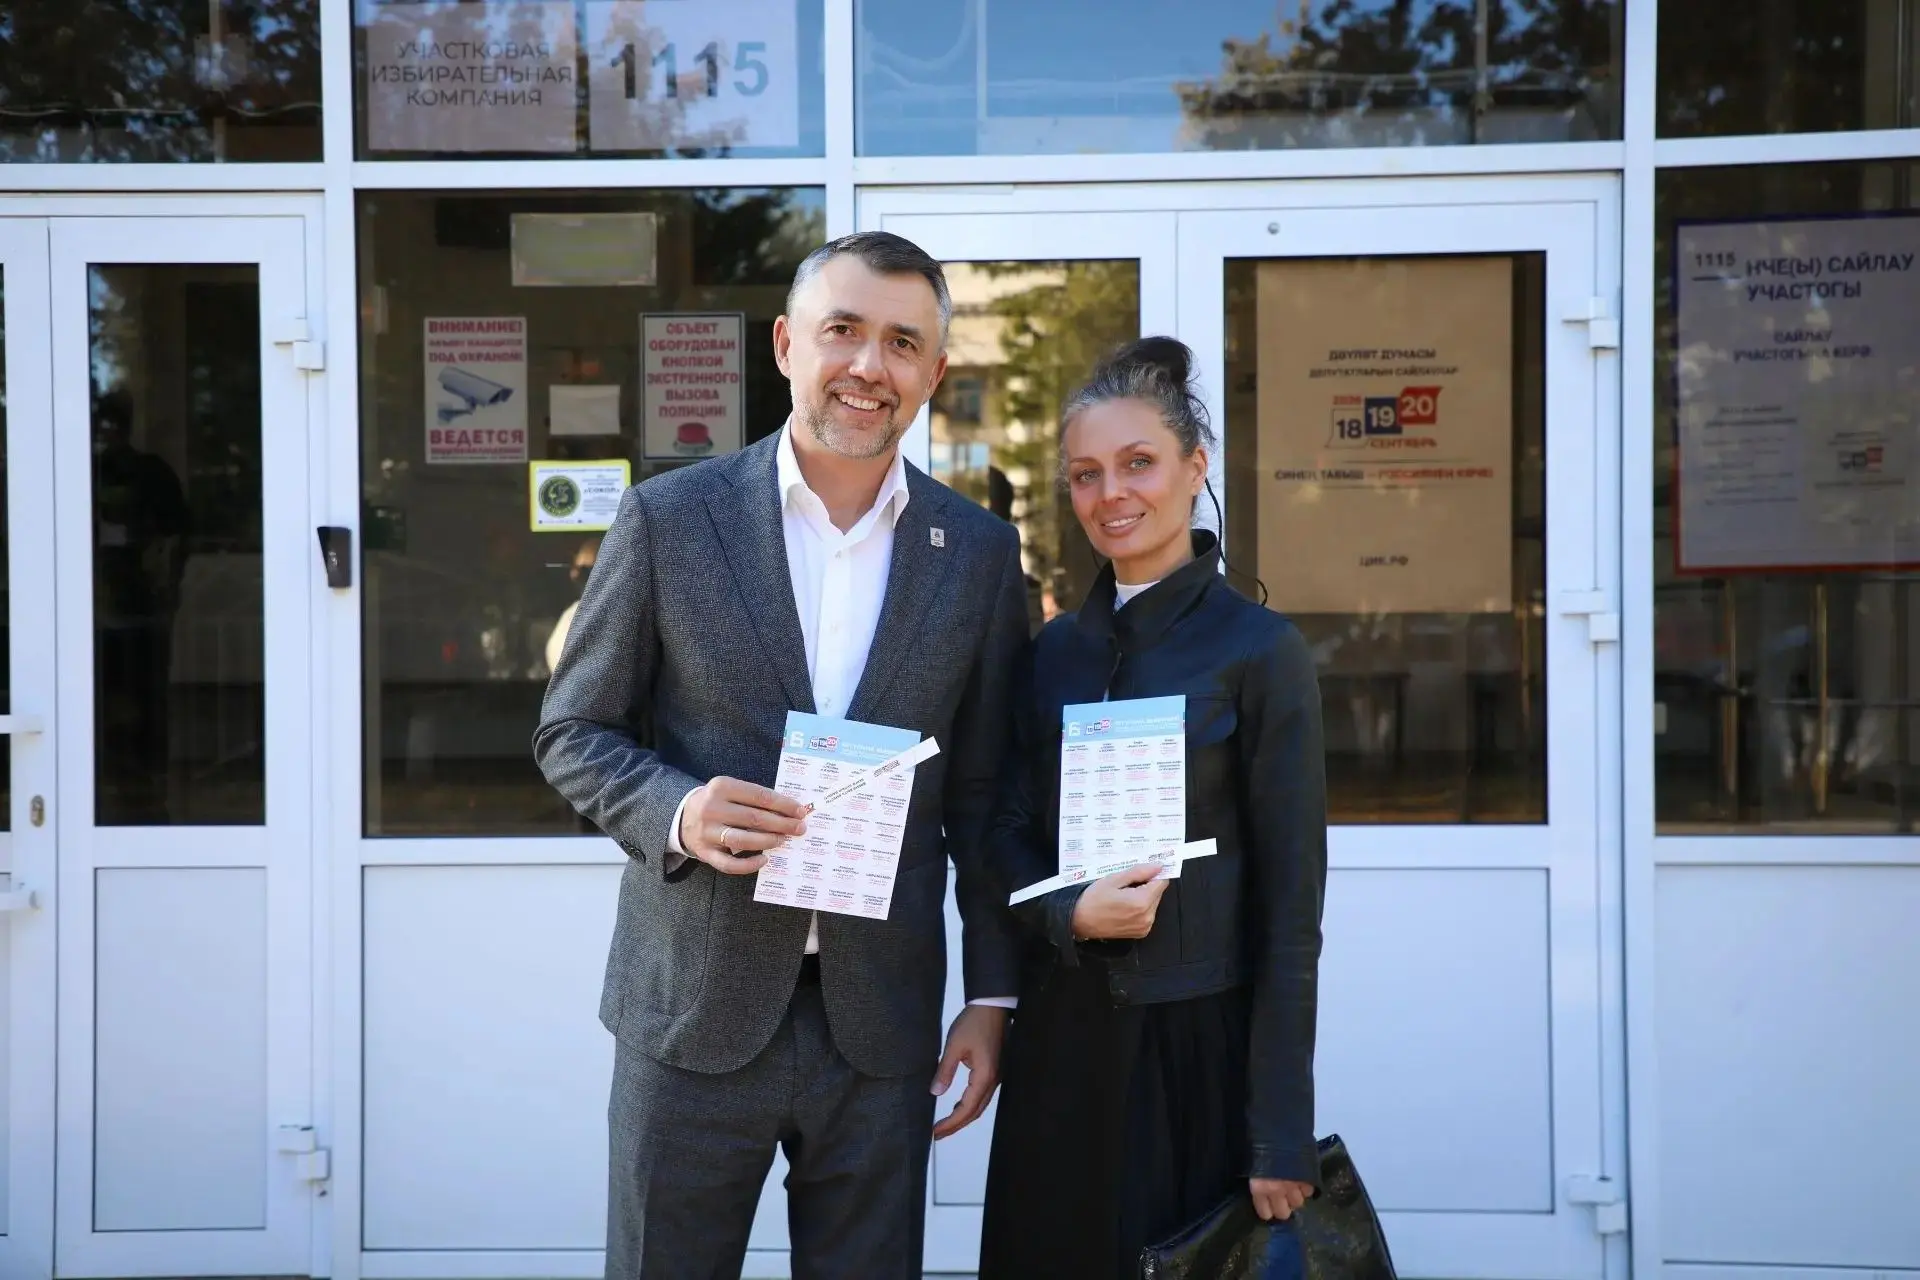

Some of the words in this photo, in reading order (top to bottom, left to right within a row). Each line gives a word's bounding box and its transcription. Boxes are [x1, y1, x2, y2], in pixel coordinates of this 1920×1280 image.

[397, 41, 550, 60] УЧАСТКОВАЯ
[371, 65, 573, 84] ИЗБИРАТЕЛЬНАЯ
[610, 41, 770, 99] 1115
[406, 89, 542, 107] КОМПАНИЯ
[1695, 252, 1736, 268] 1115
[1827, 252, 1914, 274] САЙЛАУ
[1746, 281, 1862, 302] УЧАСТОГЫ
[665, 322, 719, 335] ОБЪЕКТ
[649, 338, 736, 351] ОБОРУДОВАН
[662, 355, 724, 368] КНОПКОЙ
[647, 372, 739, 384] ЭКСТРЕННОГО
[665, 388, 720, 401] ВЫЗОВА
[1336, 419, 1362, 440] 18
[1367, 406, 1396, 428] 19
[1401, 395, 1434, 417] 20
[430, 429, 524, 447] ВЕДЕТСЯ
